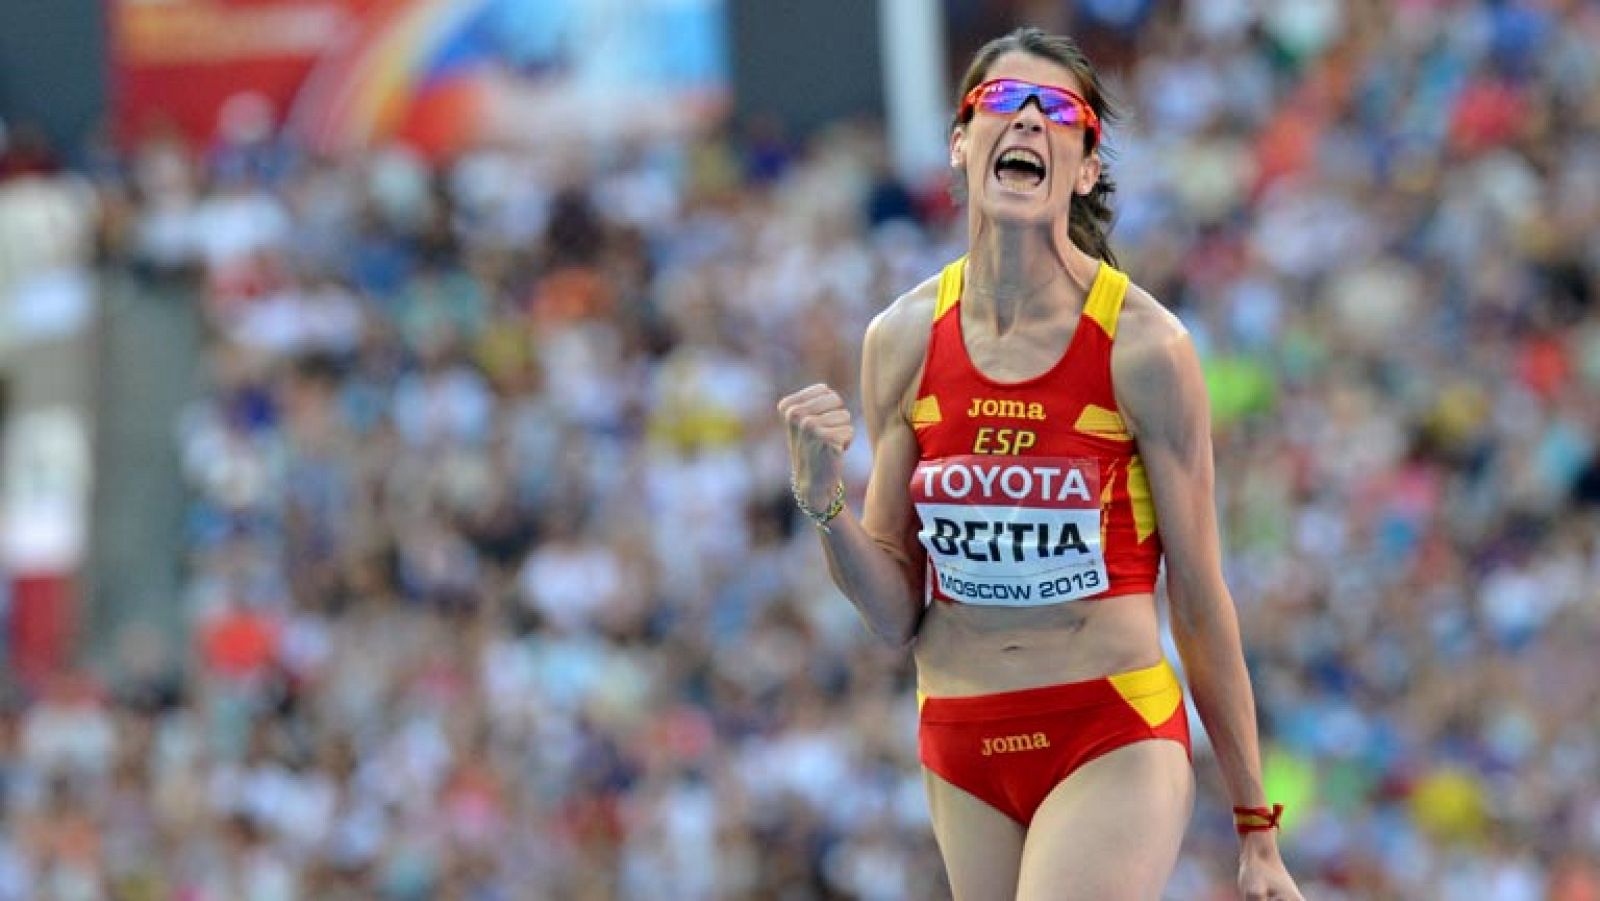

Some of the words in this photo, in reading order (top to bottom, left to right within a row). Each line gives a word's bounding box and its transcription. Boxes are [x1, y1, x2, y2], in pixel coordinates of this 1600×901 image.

[973, 427, 1036, 455] ESP
[920, 464, 1091, 501] TOYOTA
[931, 517, 1090, 562] BEITIA
[940, 572, 1031, 600] MOSCOW
[1039, 570, 1099, 598] 2013
